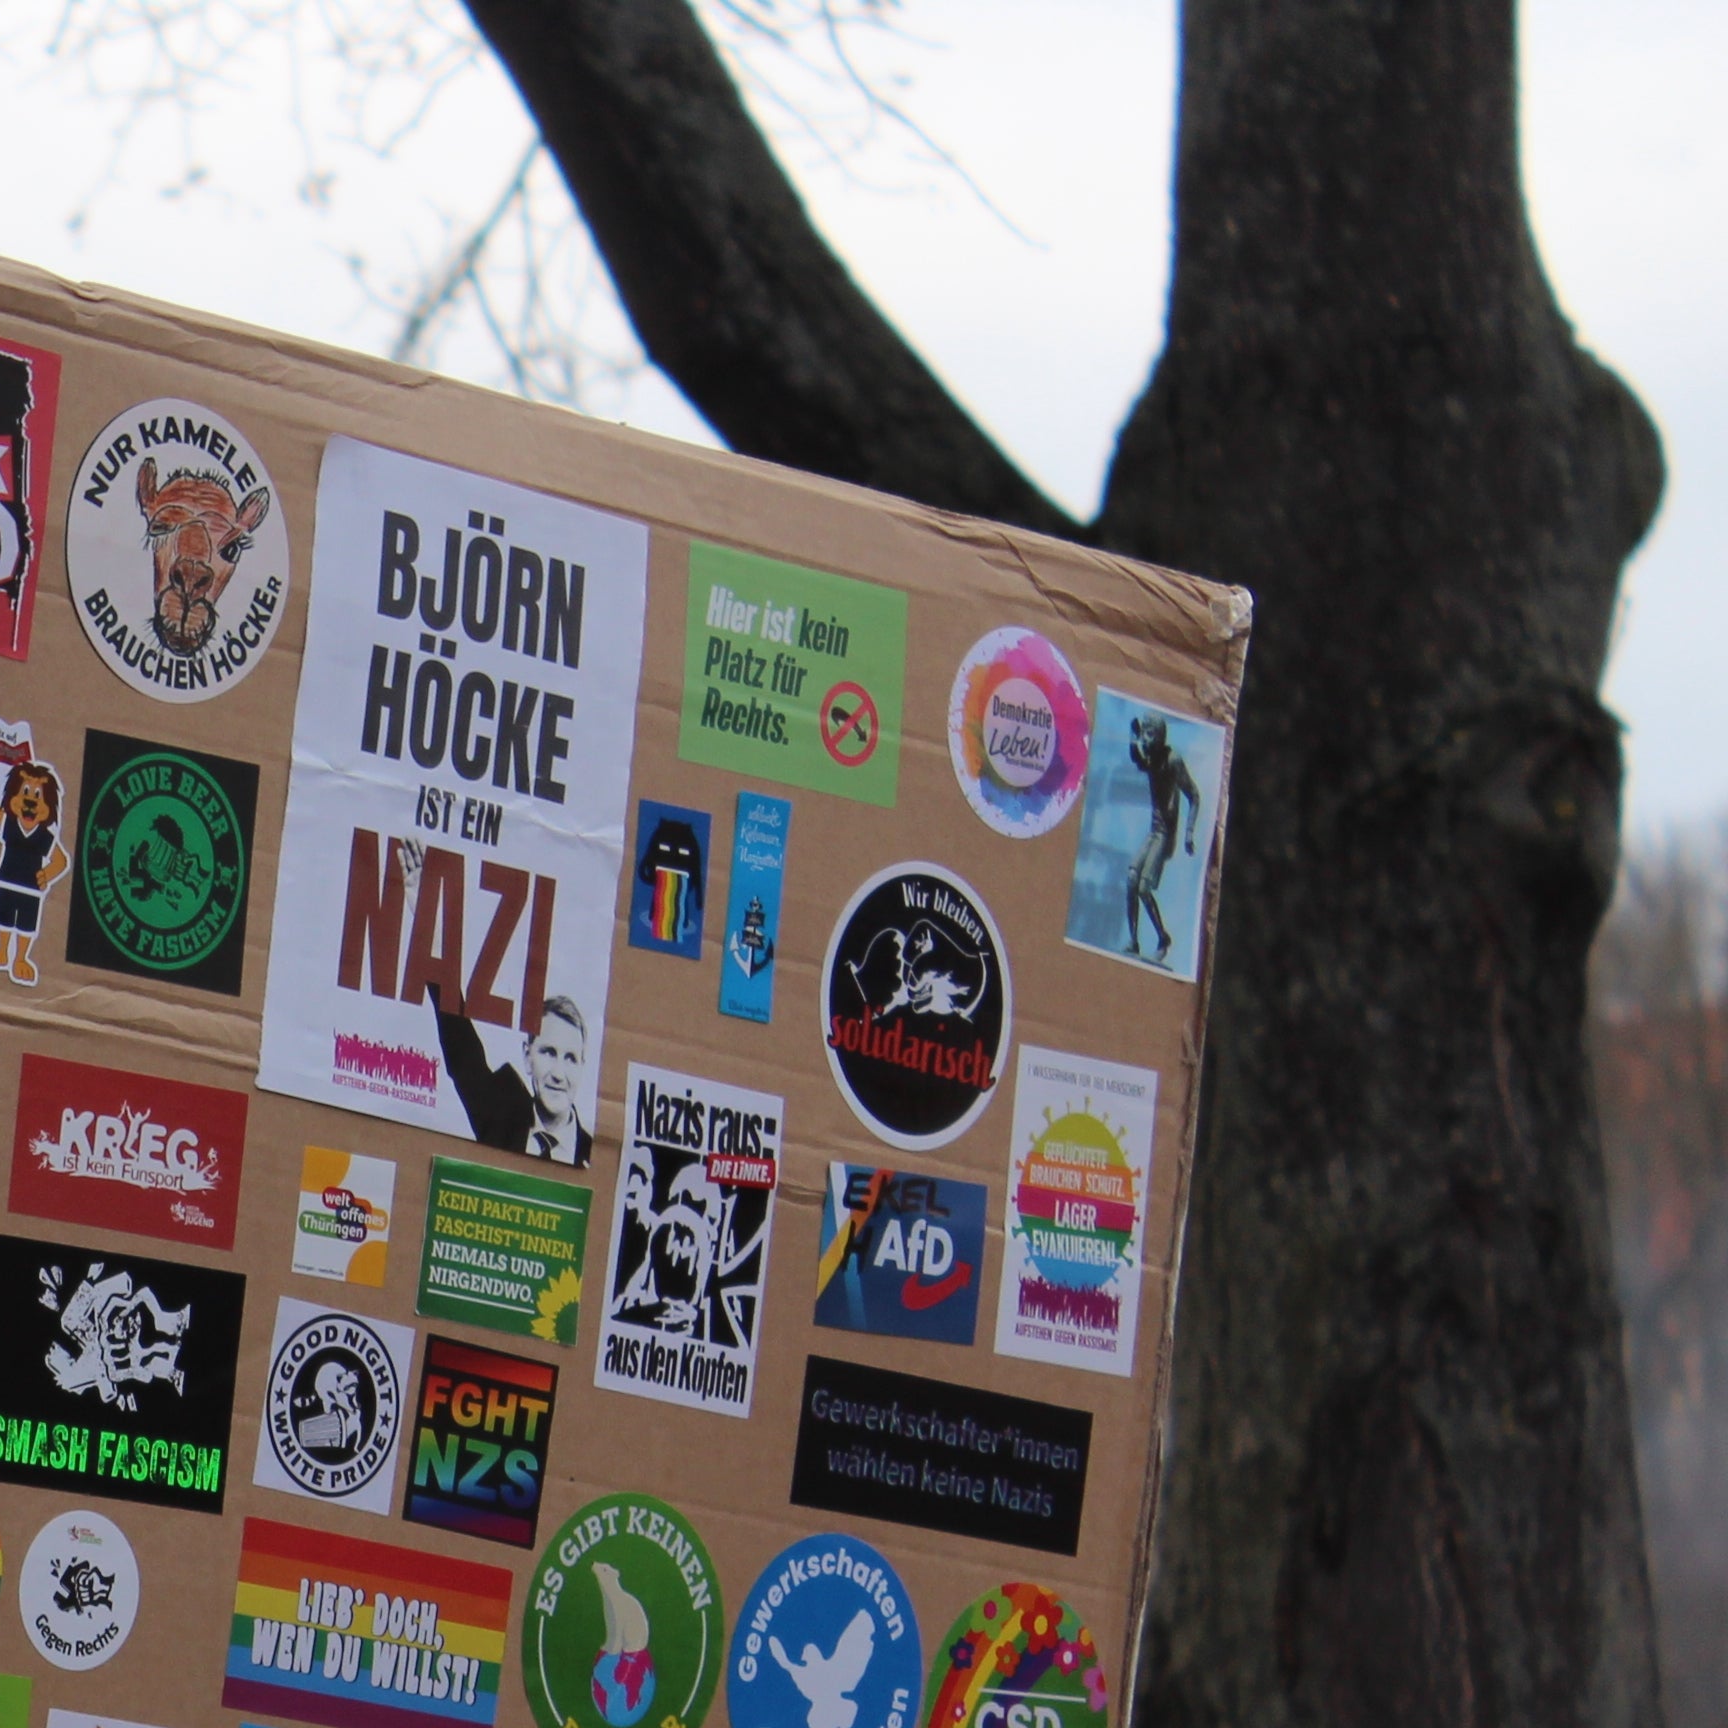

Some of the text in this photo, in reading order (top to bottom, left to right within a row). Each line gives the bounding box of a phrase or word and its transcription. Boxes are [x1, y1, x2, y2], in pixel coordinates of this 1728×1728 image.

[84, 416, 257, 508] NUR KAMELE
[376, 509, 586, 670] BJÖRN
[705, 583, 850, 658] Hier ist kein
[85, 575, 282, 690] BRAUCHEN HÖCKER
[704, 636, 808, 698] Platz für
[360, 632, 575, 805] HÖCKE
[701, 686, 789, 746] Rechts.
[989, 726, 1049, 760] Leben!
[993, 695, 1053, 731] Demokratie
[115, 767, 231, 841] LOVE BEER
[415, 784, 503, 846] IST EIN
[89, 869, 228, 960] HATE FASCISM
[337, 826, 557, 1036] NAZI
[902, 881, 985, 946] Wir bleiben
[827, 1003, 996, 1093] solidarisch
[636, 1079, 704, 1151] Nazis
[62, 1154, 185, 1191] ist kein Funsport
[1029, 1163, 1126, 1198] BRAUCHEN SCHUTZ.
[1043, 1141, 1109, 1170] GEFLÜCHTETE
[324, 1192, 352, 1208] welt
[340, 1207, 385, 1227] offenes
[437, 1189, 561, 1232] KEIN PAKT MIT
[842, 1173, 951, 1218] EKEL
[1054, 1200, 1097, 1232] LAGER
[302, 1214, 364, 1240] Thüringen
[873, 1218, 954, 1276] AfD
[1032, 1229, 1117, 1268] EVAKUIEREN!
[427, 1265, 535, 1304] NIRGENDWO.
[431, 1239, 545, 1280] NIEMALS UND
[280, 1325, 394, 1405] GOOD NIGHT
[604, 1332, 748, 1404] aus den Köpfen
[422, 1373, 548, 1442] FGHT
[97, 1431, 221, 1493] FASCISM
[273, 1411, 388, 1488] WHITE PRIDE
[413, 1428, 538, 1508] NZS
[828, 1446, 1054, 1518] wählen keine Nazis
[535, 1506, 712, 1616] ES GIBT KEINEN
[35, 1614, 121, 1658] Gegen Rechts
[371, 1592, 444, 1651] DOCH,
[739, 1547, 906, 1682] Gewerkschaften
[251, 1618, 480, 1706] WEN DU WILLST!
